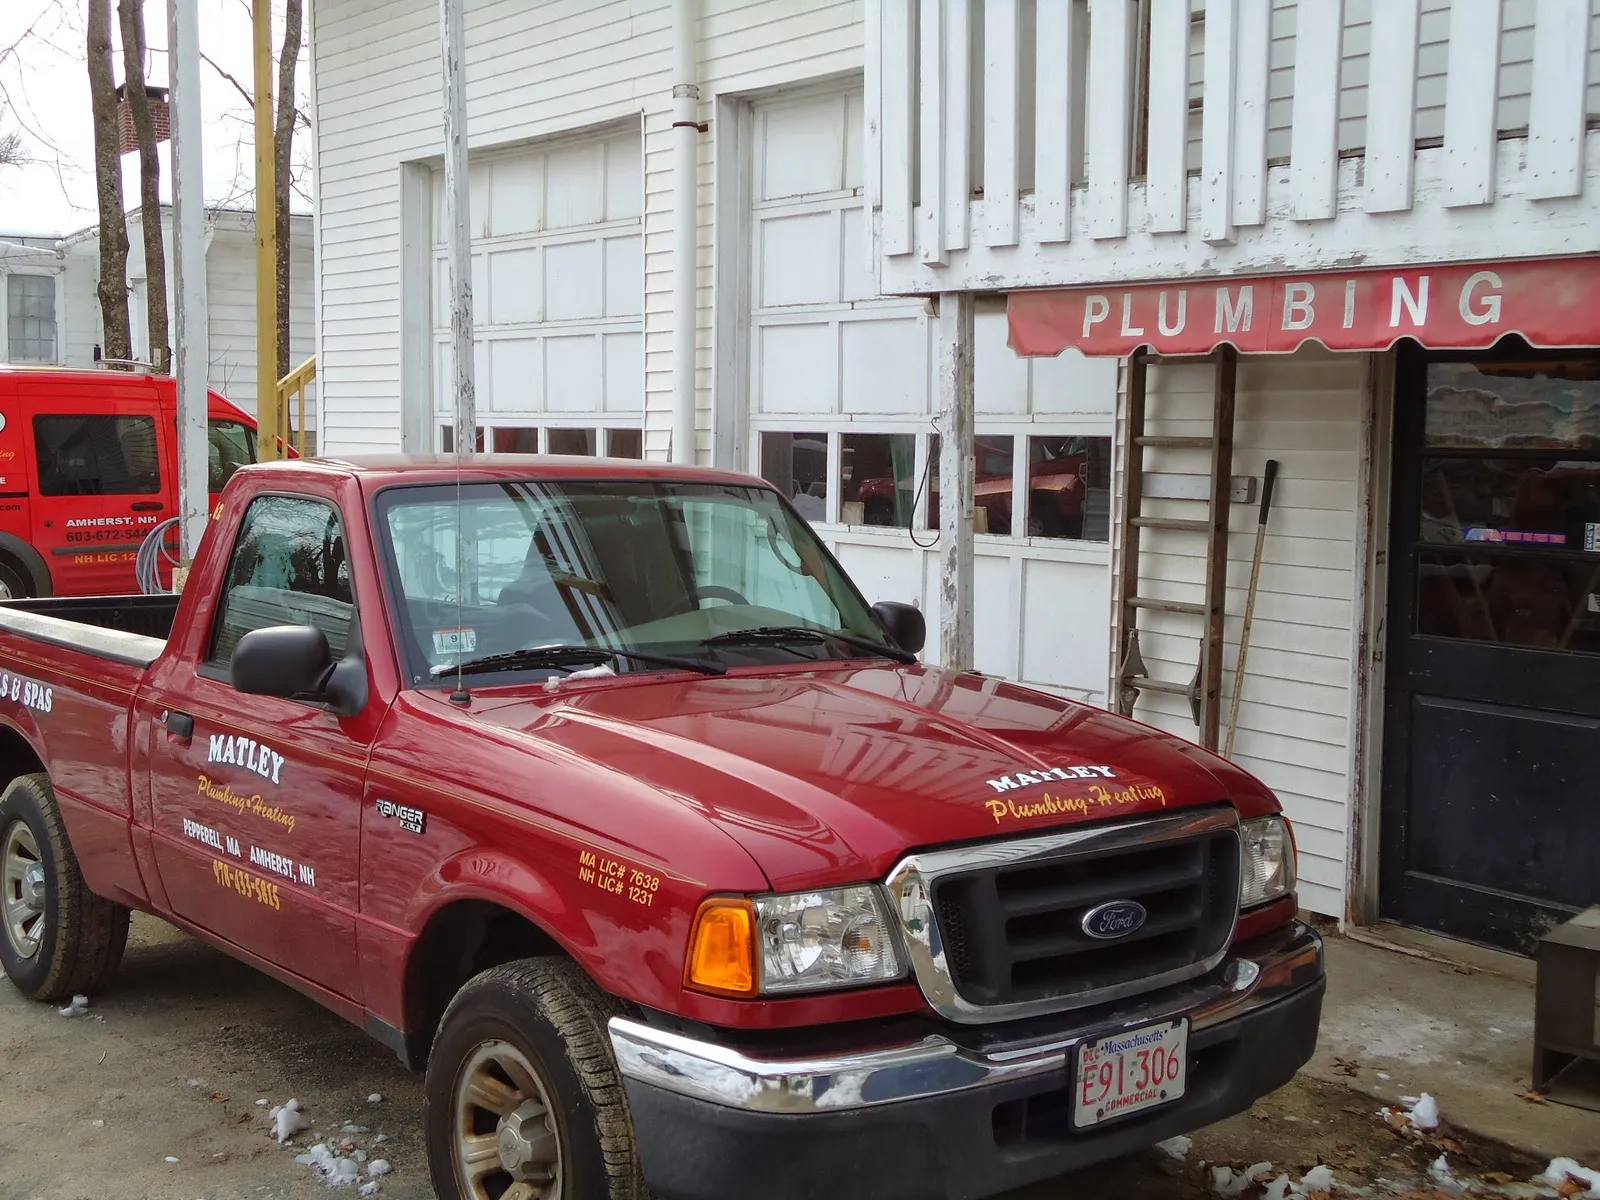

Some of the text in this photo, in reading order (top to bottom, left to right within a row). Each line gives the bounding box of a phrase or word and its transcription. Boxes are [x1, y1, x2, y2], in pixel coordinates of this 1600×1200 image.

[1082, 270, 1504, 339] PLUMBING
[66, 517, 134, 527] AMHERST,
[66, 529, 149, 542] 603-672-544
[98, 554, 117, 562] LIC
[122, 552, 136, 560] 12
[23, 681, 53, 713] SPAS
[207, 734, 285, 785] MATLEY
[985, 765, 1117, 793] MATLEY
[376, 799, 423, 825] RANGER
[401, 820, 419, 832] XLT
[183, 818, 316, 887] PEPPERELL, MA AMHERST, NH
[579, 850, 660, 892] MA LIC# 7638
[578, 867, 653, 907] NH LIC# 1231
[1099, 908, 1134, 932] Ford
[1103, 1029, 1164, 1056] Massachusetts
[1105, 1088, 1157, 1112] COMMERCIAL
